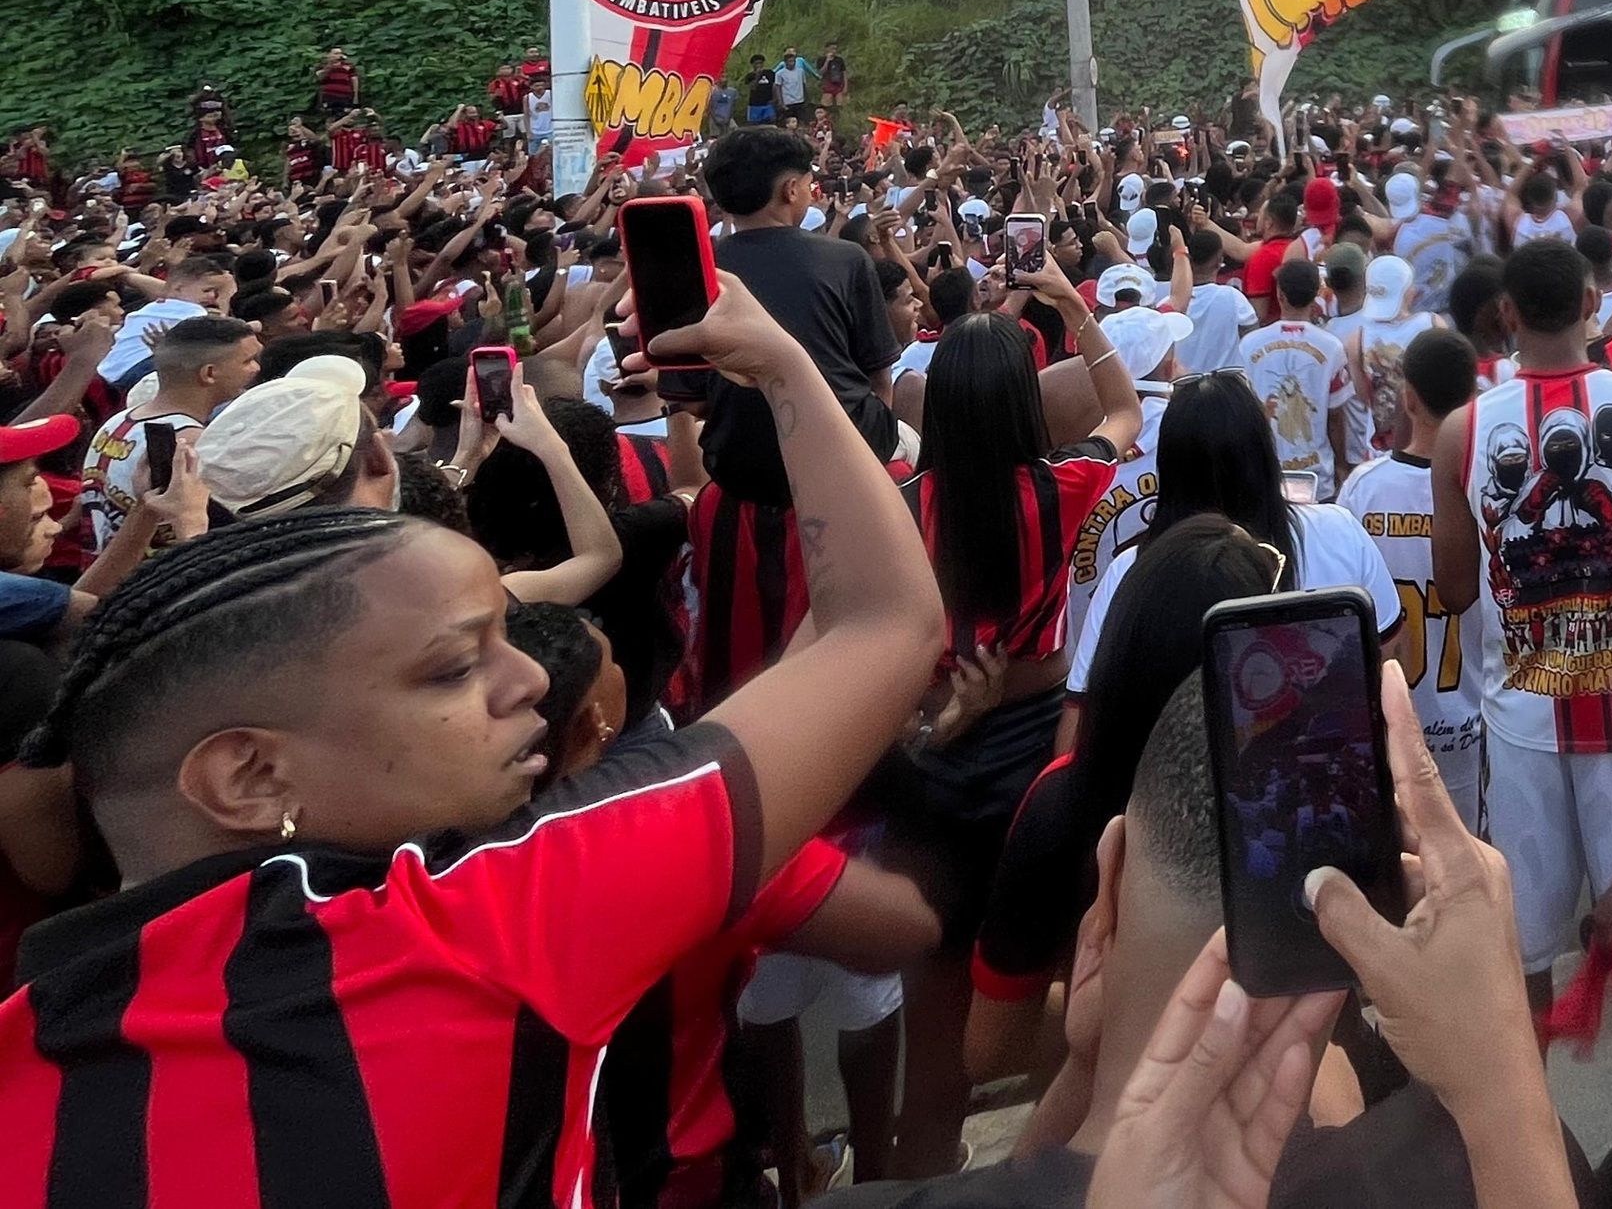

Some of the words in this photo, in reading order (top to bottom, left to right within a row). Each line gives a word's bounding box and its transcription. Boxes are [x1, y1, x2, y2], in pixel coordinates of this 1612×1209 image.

[1074, 484, 1137, 585] CONTRA
[1363, 513, 1386, 537] OS
[1423, 719, 1455, 736] além
